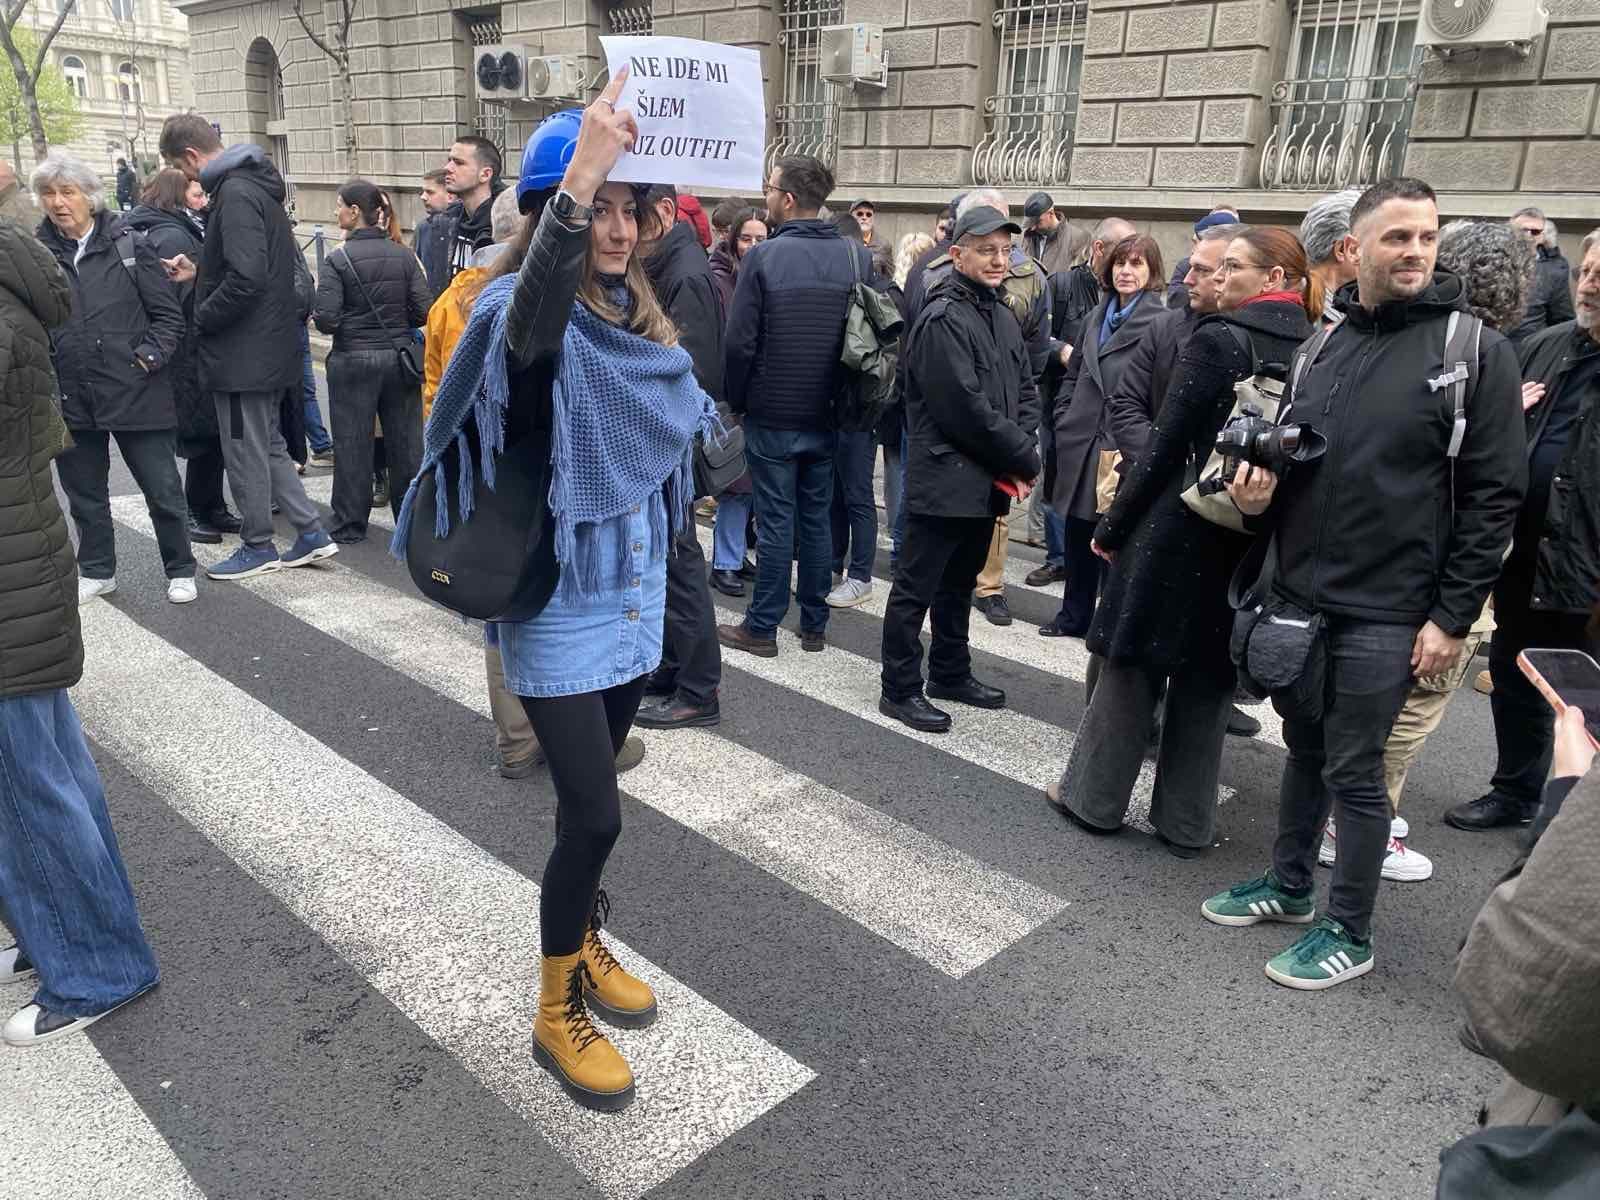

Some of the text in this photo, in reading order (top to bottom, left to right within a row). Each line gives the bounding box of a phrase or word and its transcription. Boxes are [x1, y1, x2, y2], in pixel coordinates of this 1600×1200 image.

[631, 56, 729, 84] NE IDE MI
[637, 89, 685, 118] ŠLEM
[632, 135, 737, 160] UZ OUTFIT
